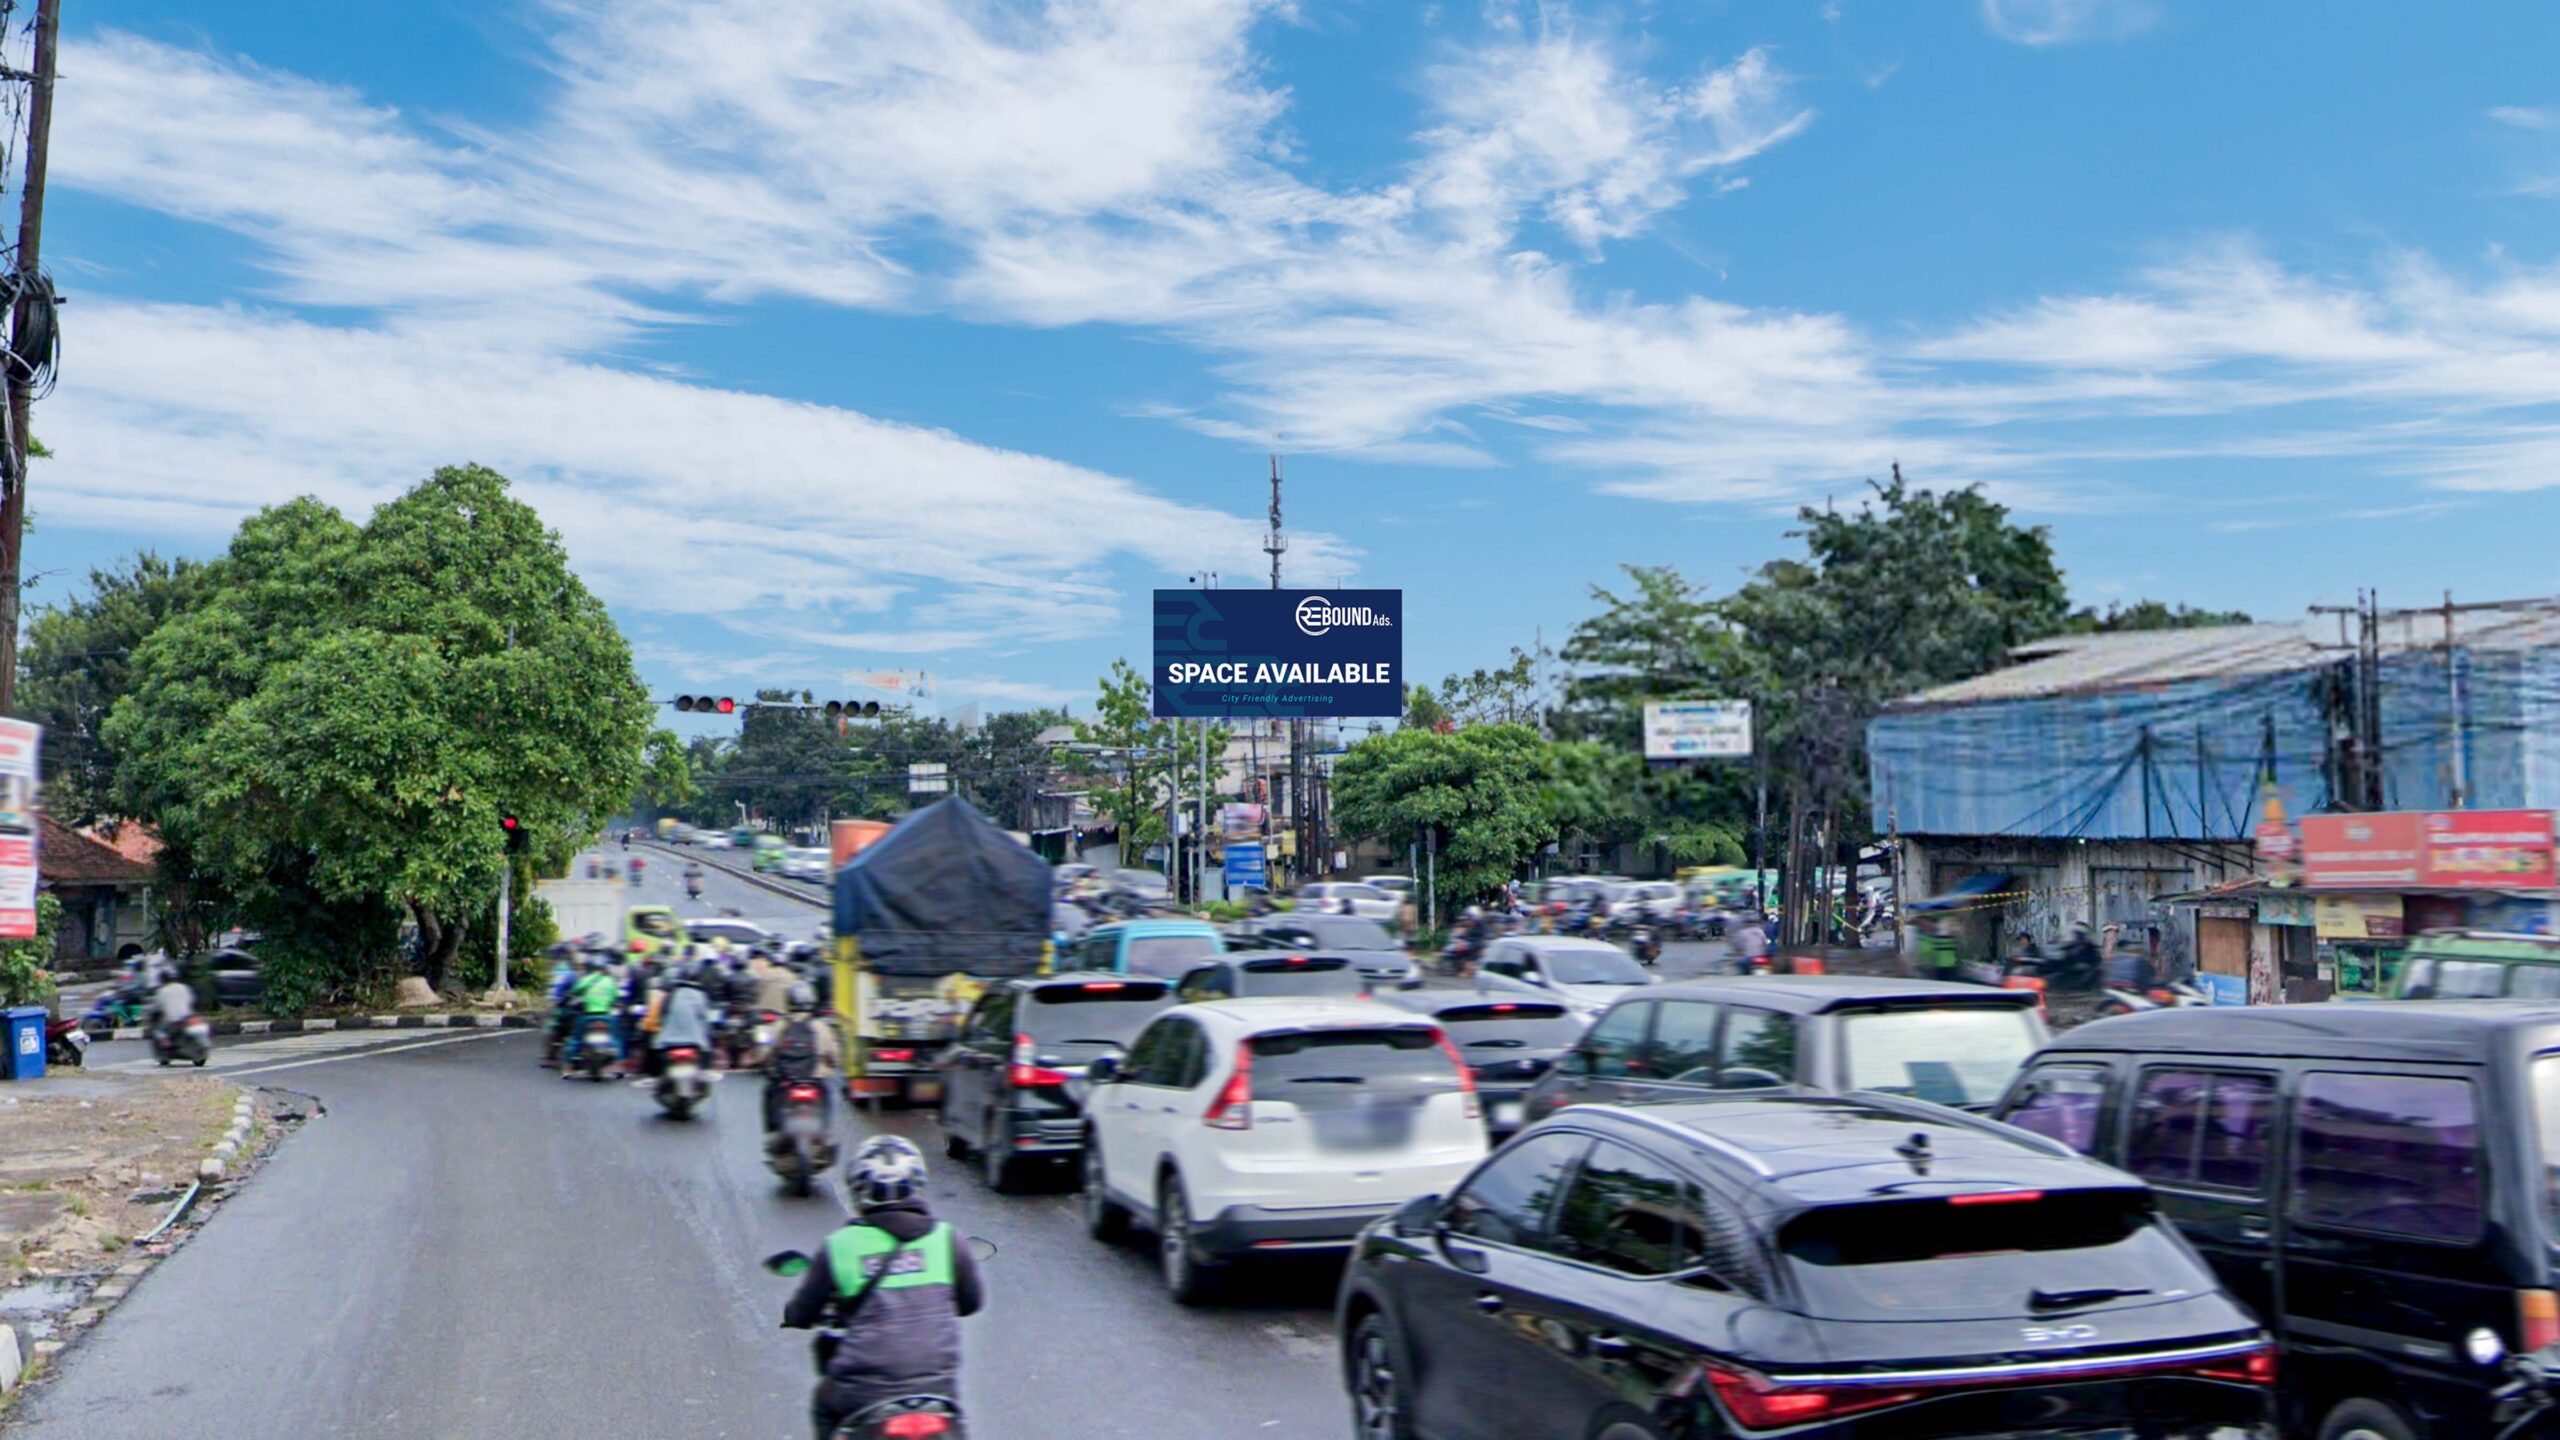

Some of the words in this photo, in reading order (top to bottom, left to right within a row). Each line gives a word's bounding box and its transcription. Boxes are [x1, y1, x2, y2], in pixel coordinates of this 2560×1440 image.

[1296, 604, 1372, 628] REBOUND
[1373, 614, 1393, 627] Ads.
[1168, 662, 1248, 684] SPACE
[1254, 663, 1390, 684] AVAILABLE
[1221, 694, 1240, 704] City
[1243, 694, 1279, 704] Friendly
[1281, 694, 1334, 704] Advertising
[2019, 1324, 2098, 1342] BYD
